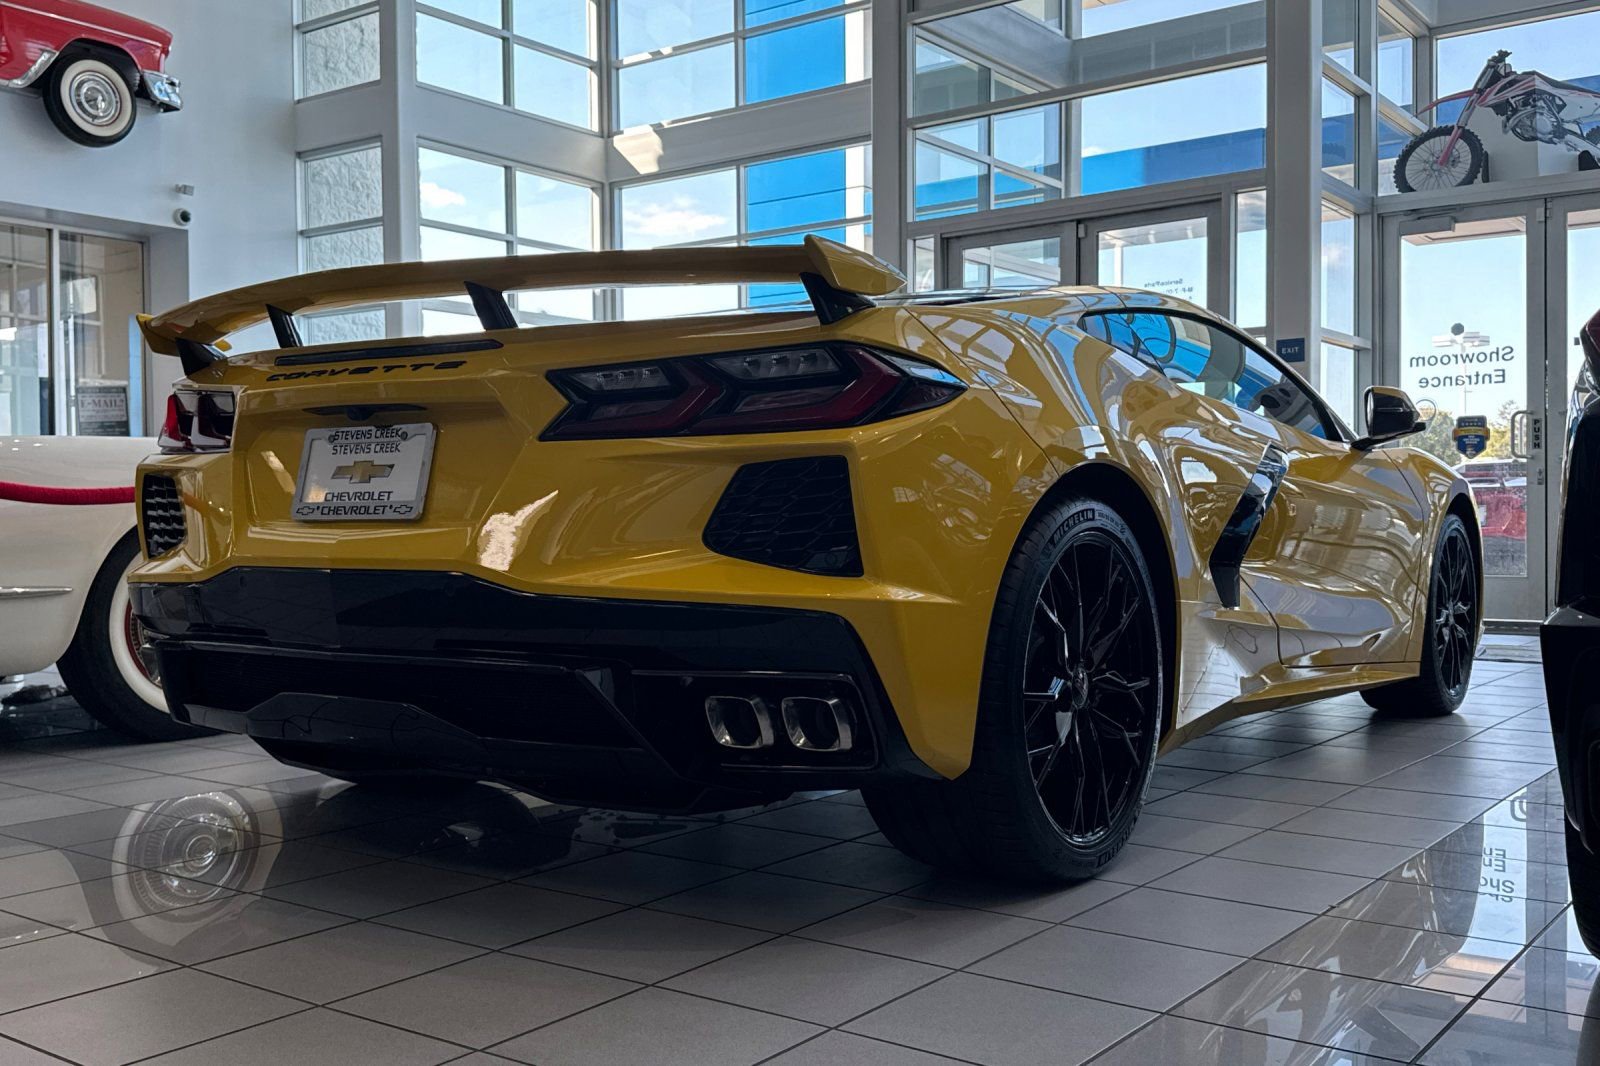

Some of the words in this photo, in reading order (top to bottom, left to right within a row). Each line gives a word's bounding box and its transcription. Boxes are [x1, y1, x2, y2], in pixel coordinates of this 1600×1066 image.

[1281, 346, 1299, 354] EXIT
[266, 360, 467, 382] CORVETTE
[334, 429, 373, 441] STEVENS
[374, 427, 402, 439] CREEK
[1533, 418, 1541, 450] PUSH
[331, 443, 372, 456] STEVENS
[373, 442, 401, 454] CREEK
[324, 490, 394, 502] CHEVROLET
[320, 505, 388, 516] CHEVROLET
[1053, 509, 1094, 544] MICHELIN
